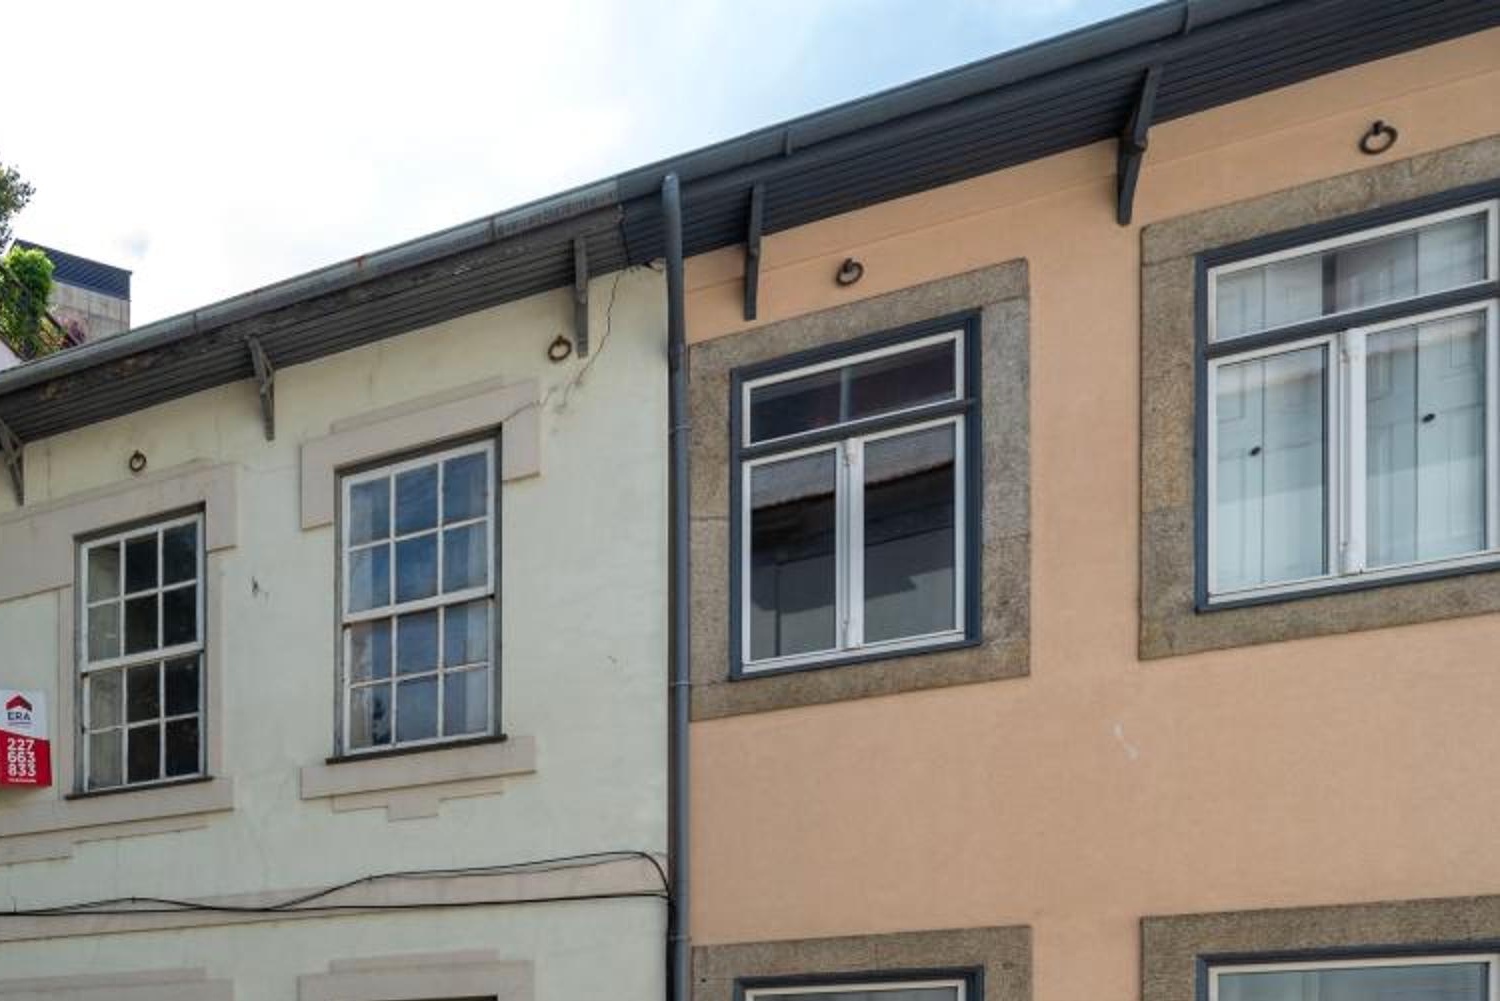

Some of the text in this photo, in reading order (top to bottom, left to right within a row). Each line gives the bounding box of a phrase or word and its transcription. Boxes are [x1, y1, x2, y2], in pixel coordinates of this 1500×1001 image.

[7, 711, 31, 721] ERA
[7, 738, 35, 751] 227
[7, 751, 36, 763] 663
[8, 763, 37, 777] 833
